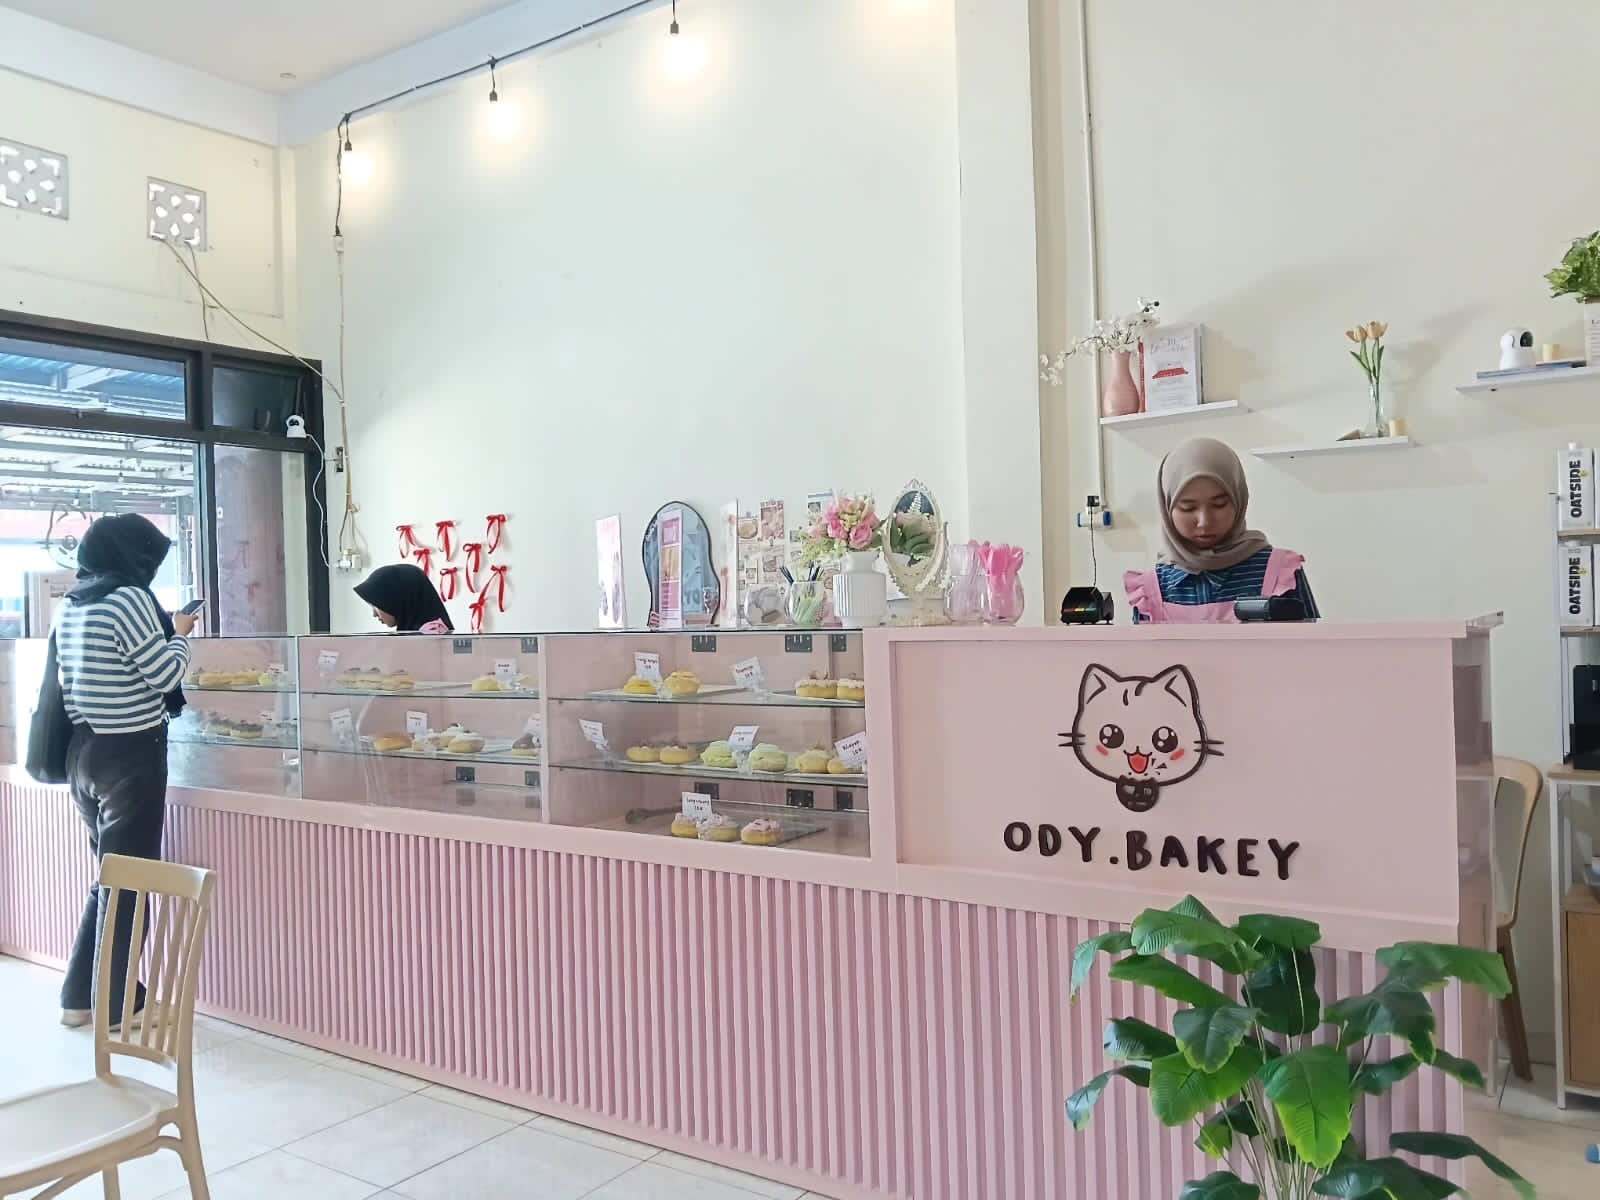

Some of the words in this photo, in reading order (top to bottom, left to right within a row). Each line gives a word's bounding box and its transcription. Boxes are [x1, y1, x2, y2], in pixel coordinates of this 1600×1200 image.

[1569, 460, 1583, 518] OATSIDE
[1569, 557, 1581, 615] OATSIDE
[1003, 821, 1300, 881] ODY.BAKEY
